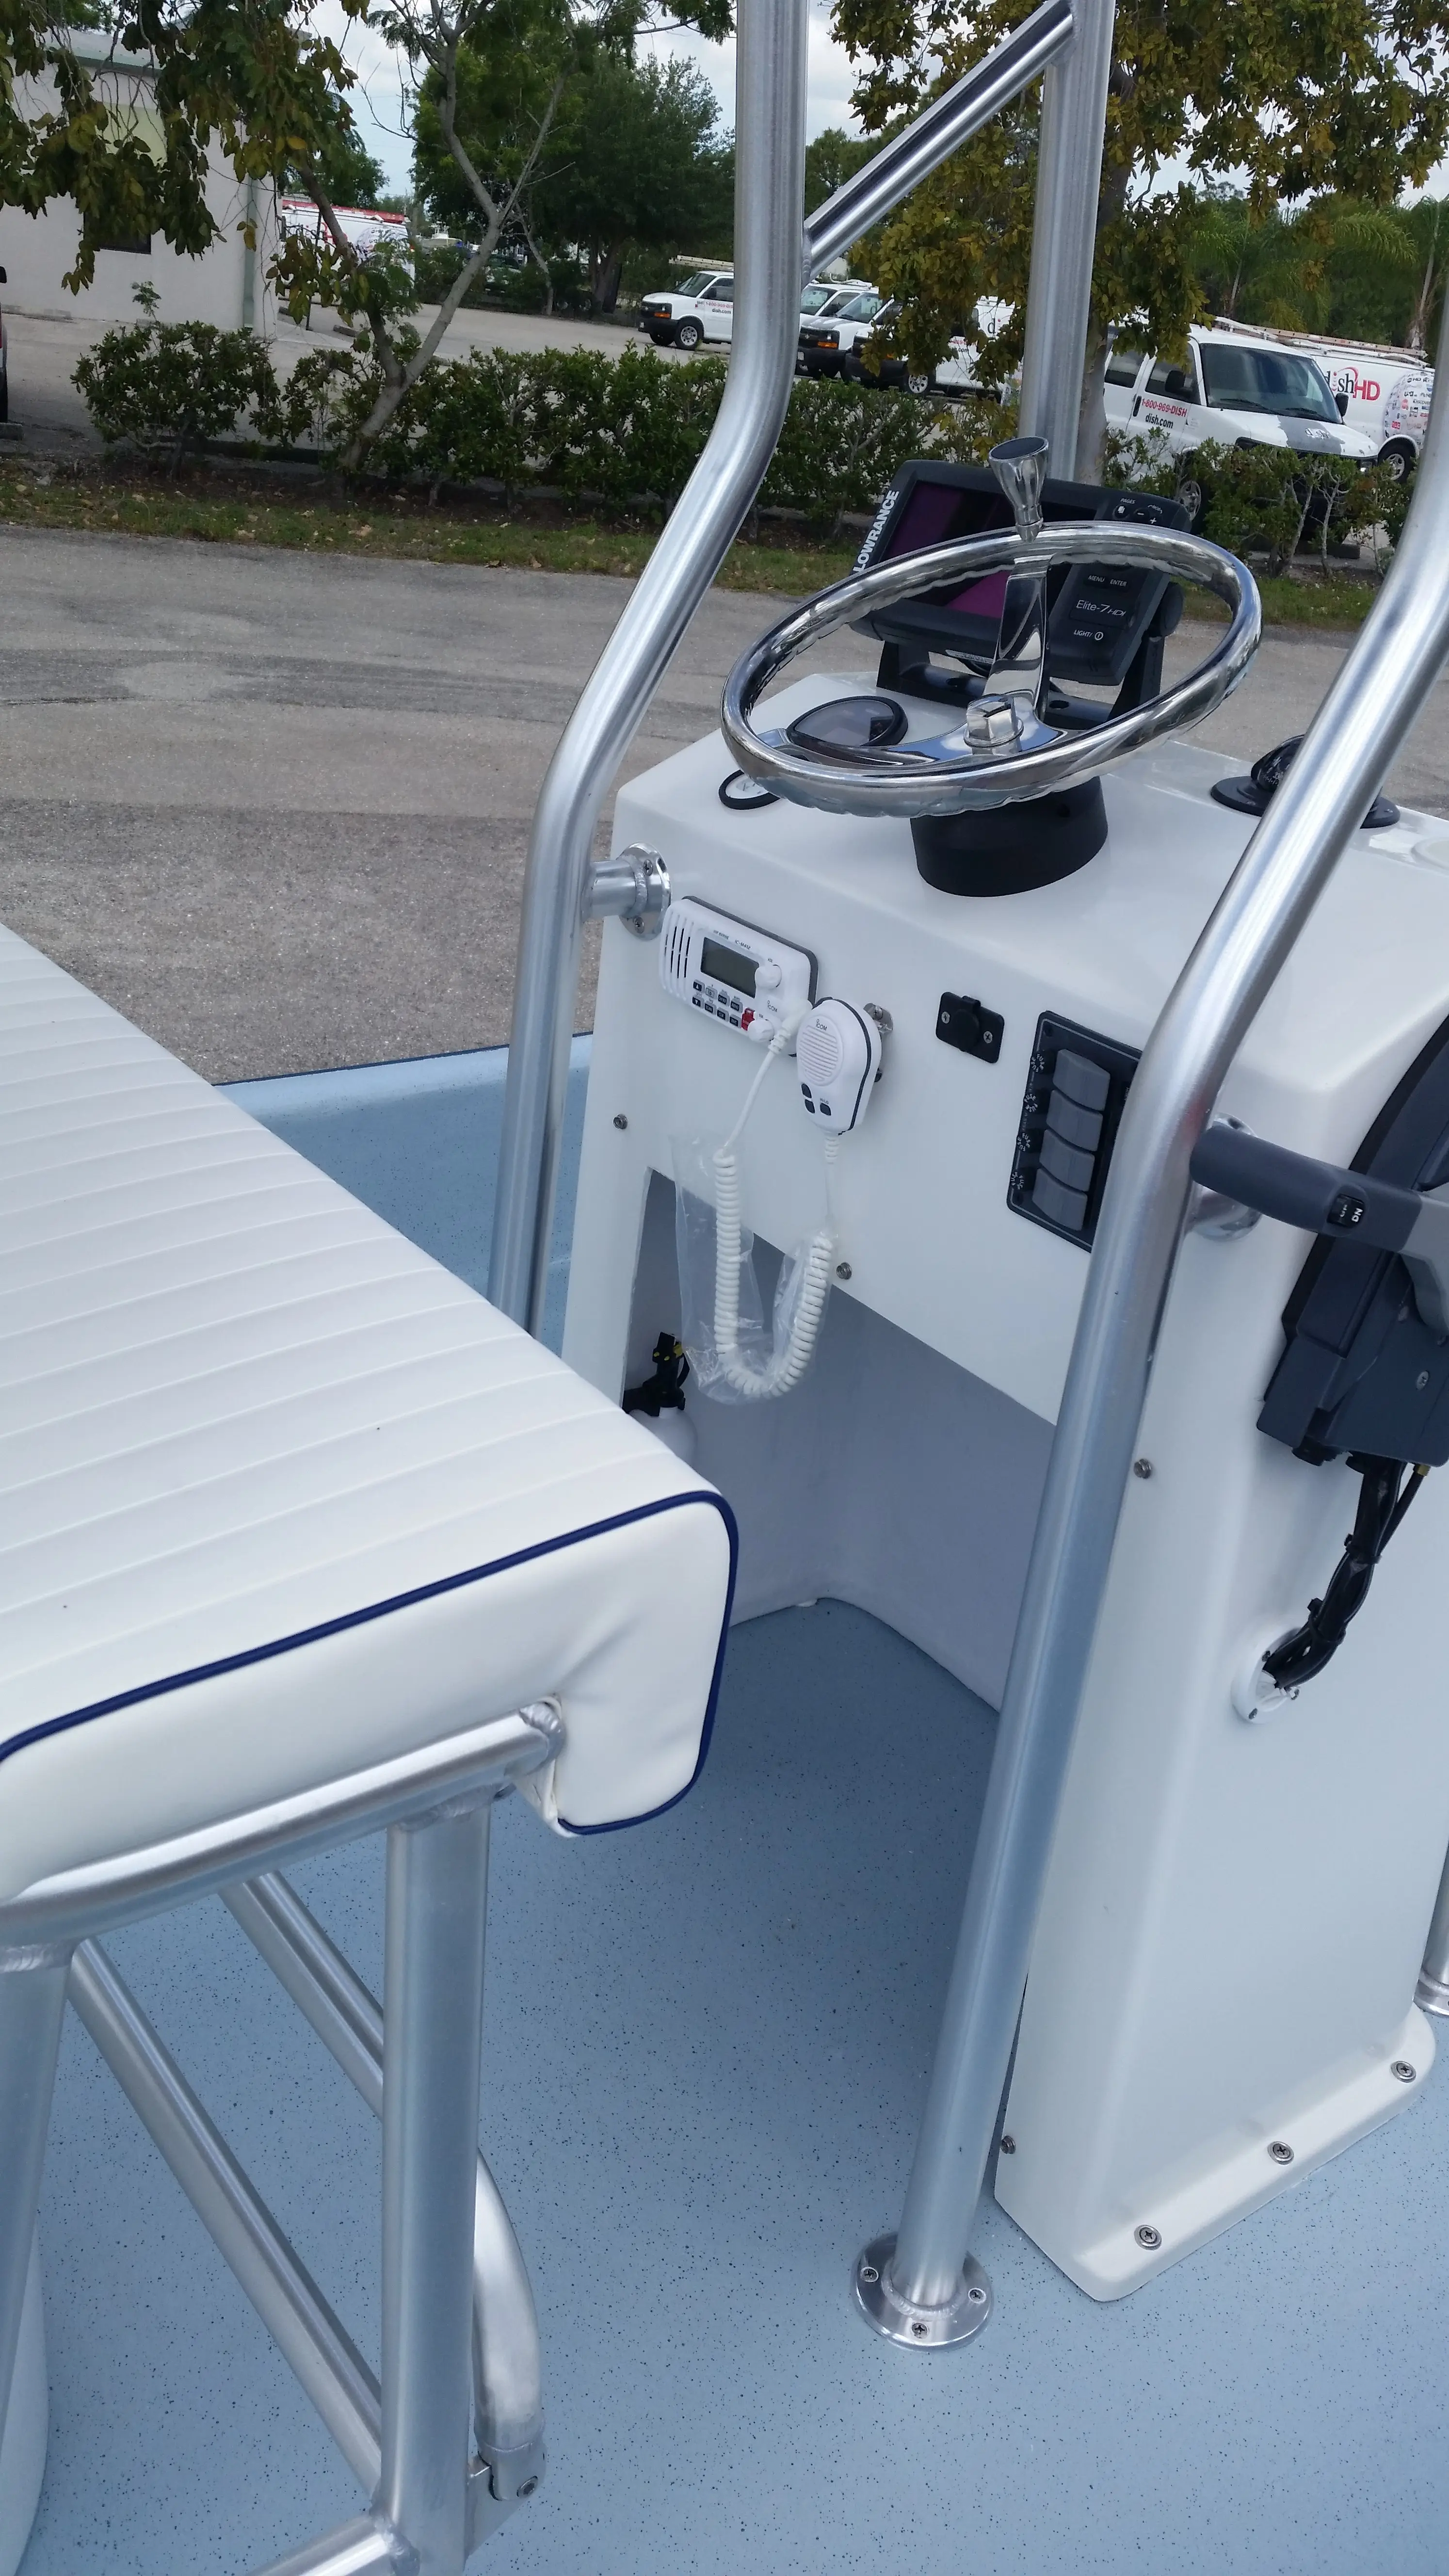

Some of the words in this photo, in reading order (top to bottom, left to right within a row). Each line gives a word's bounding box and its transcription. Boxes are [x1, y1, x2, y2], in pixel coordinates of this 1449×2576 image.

[1142, 398, 1187, 417] 1-800-969-DISH
[1145, 413, 1174, 429] dish.com
[853, 490, 900, 572] LOWRANCE
[1352, 1208, 1363, 1222] DN
